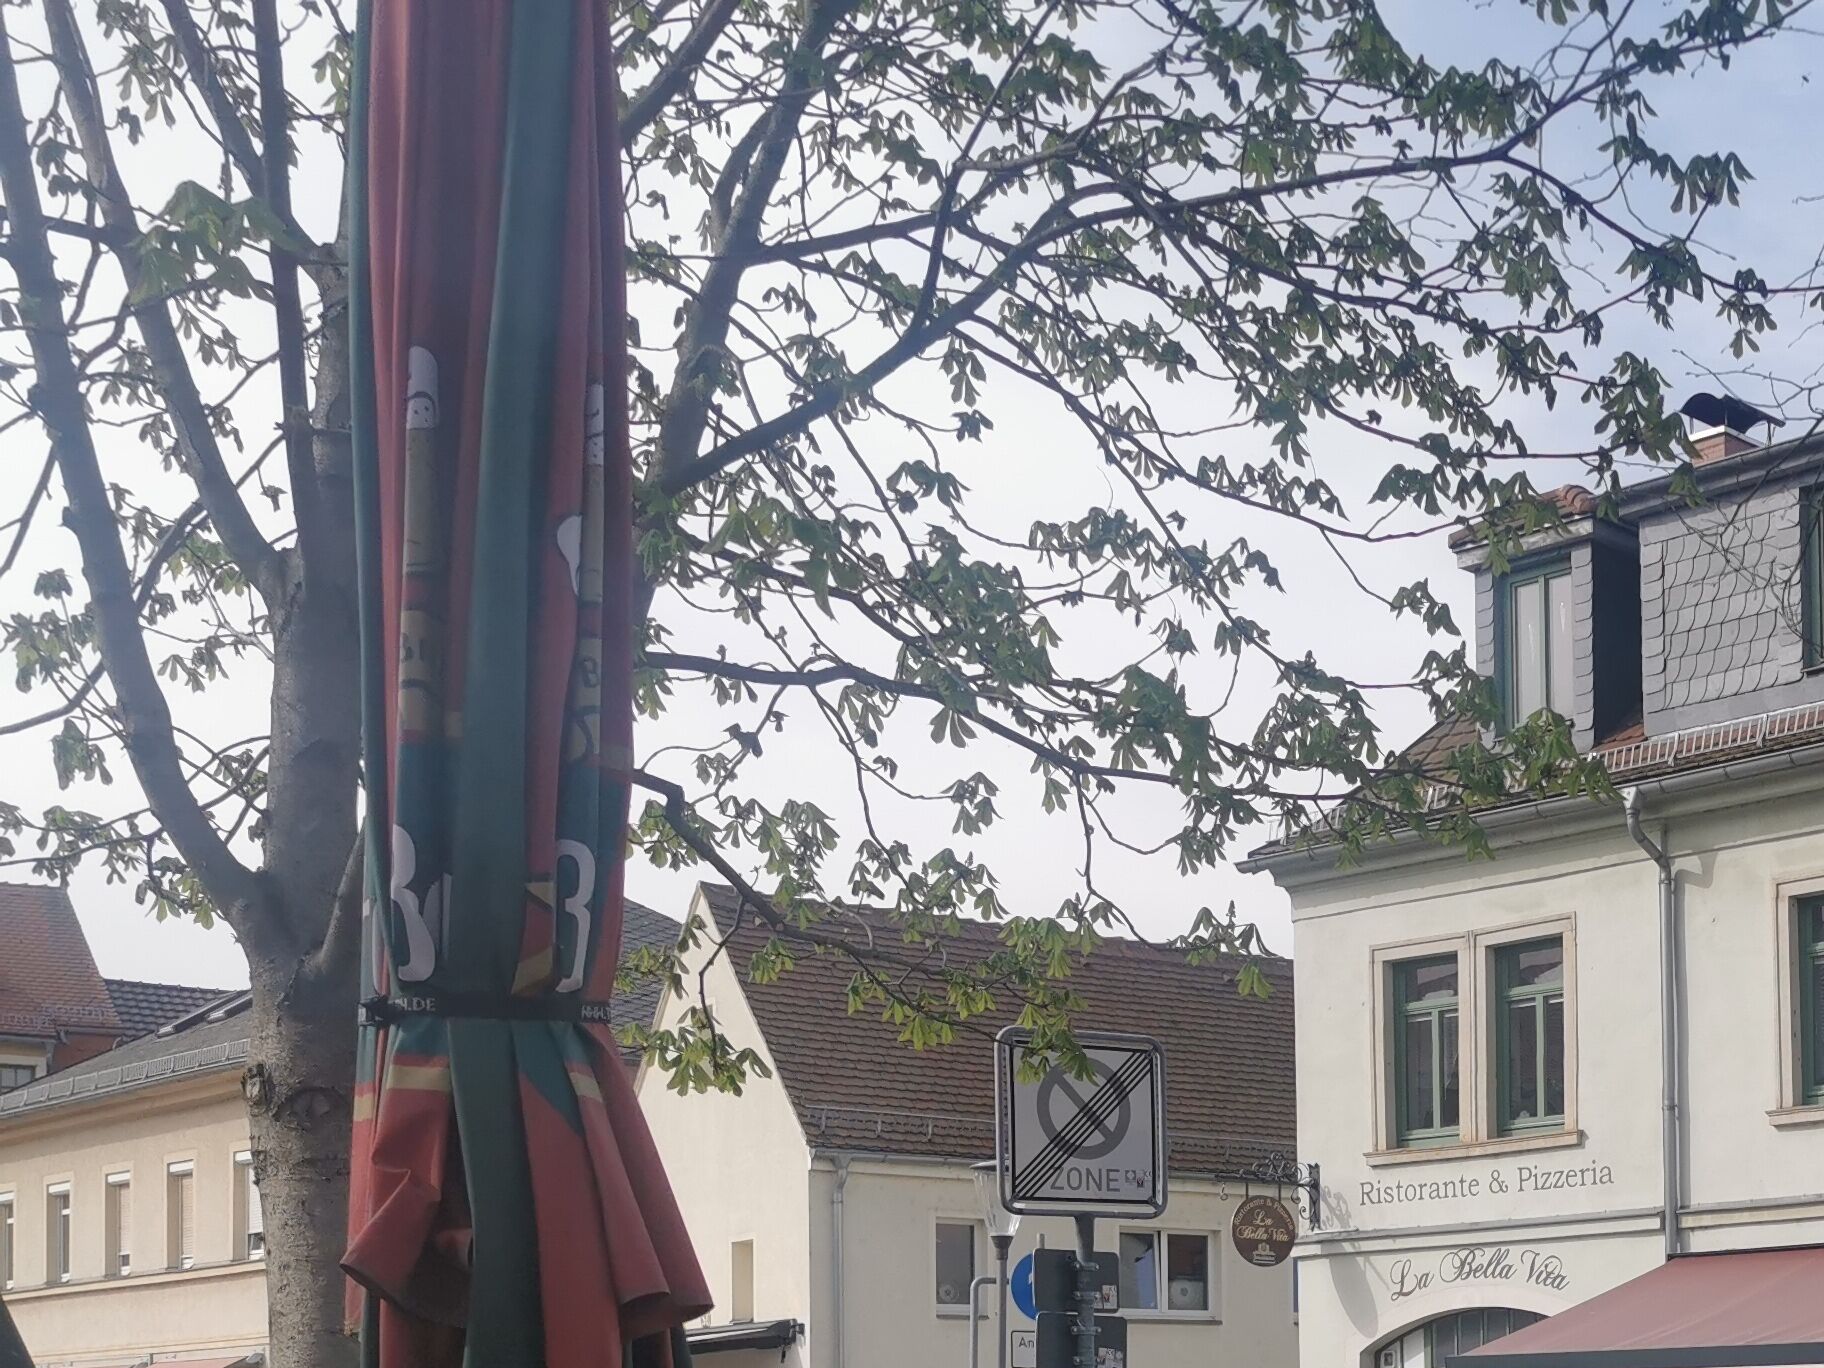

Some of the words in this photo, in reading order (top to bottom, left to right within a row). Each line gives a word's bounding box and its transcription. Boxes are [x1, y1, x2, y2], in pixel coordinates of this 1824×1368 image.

[1050, 1167, 1120, 1192] ZONE
[1359, 1172, 1480, 1206] Ristorante
[1488, 1170, 1509, 1194] &
[1517, 1160, 1614, 1192] Pizzeria
[1253, 1209, 1274, 1226] La
[1236, 1225, 1269, 1240] Bella
[1268, 1228, 1290, 1242] Vita
[1390, 1257, 1435, 1302] La
[1439, 1247, 1518, 1284] Bella
[1520, 1249, 1571, 1291] Vita
